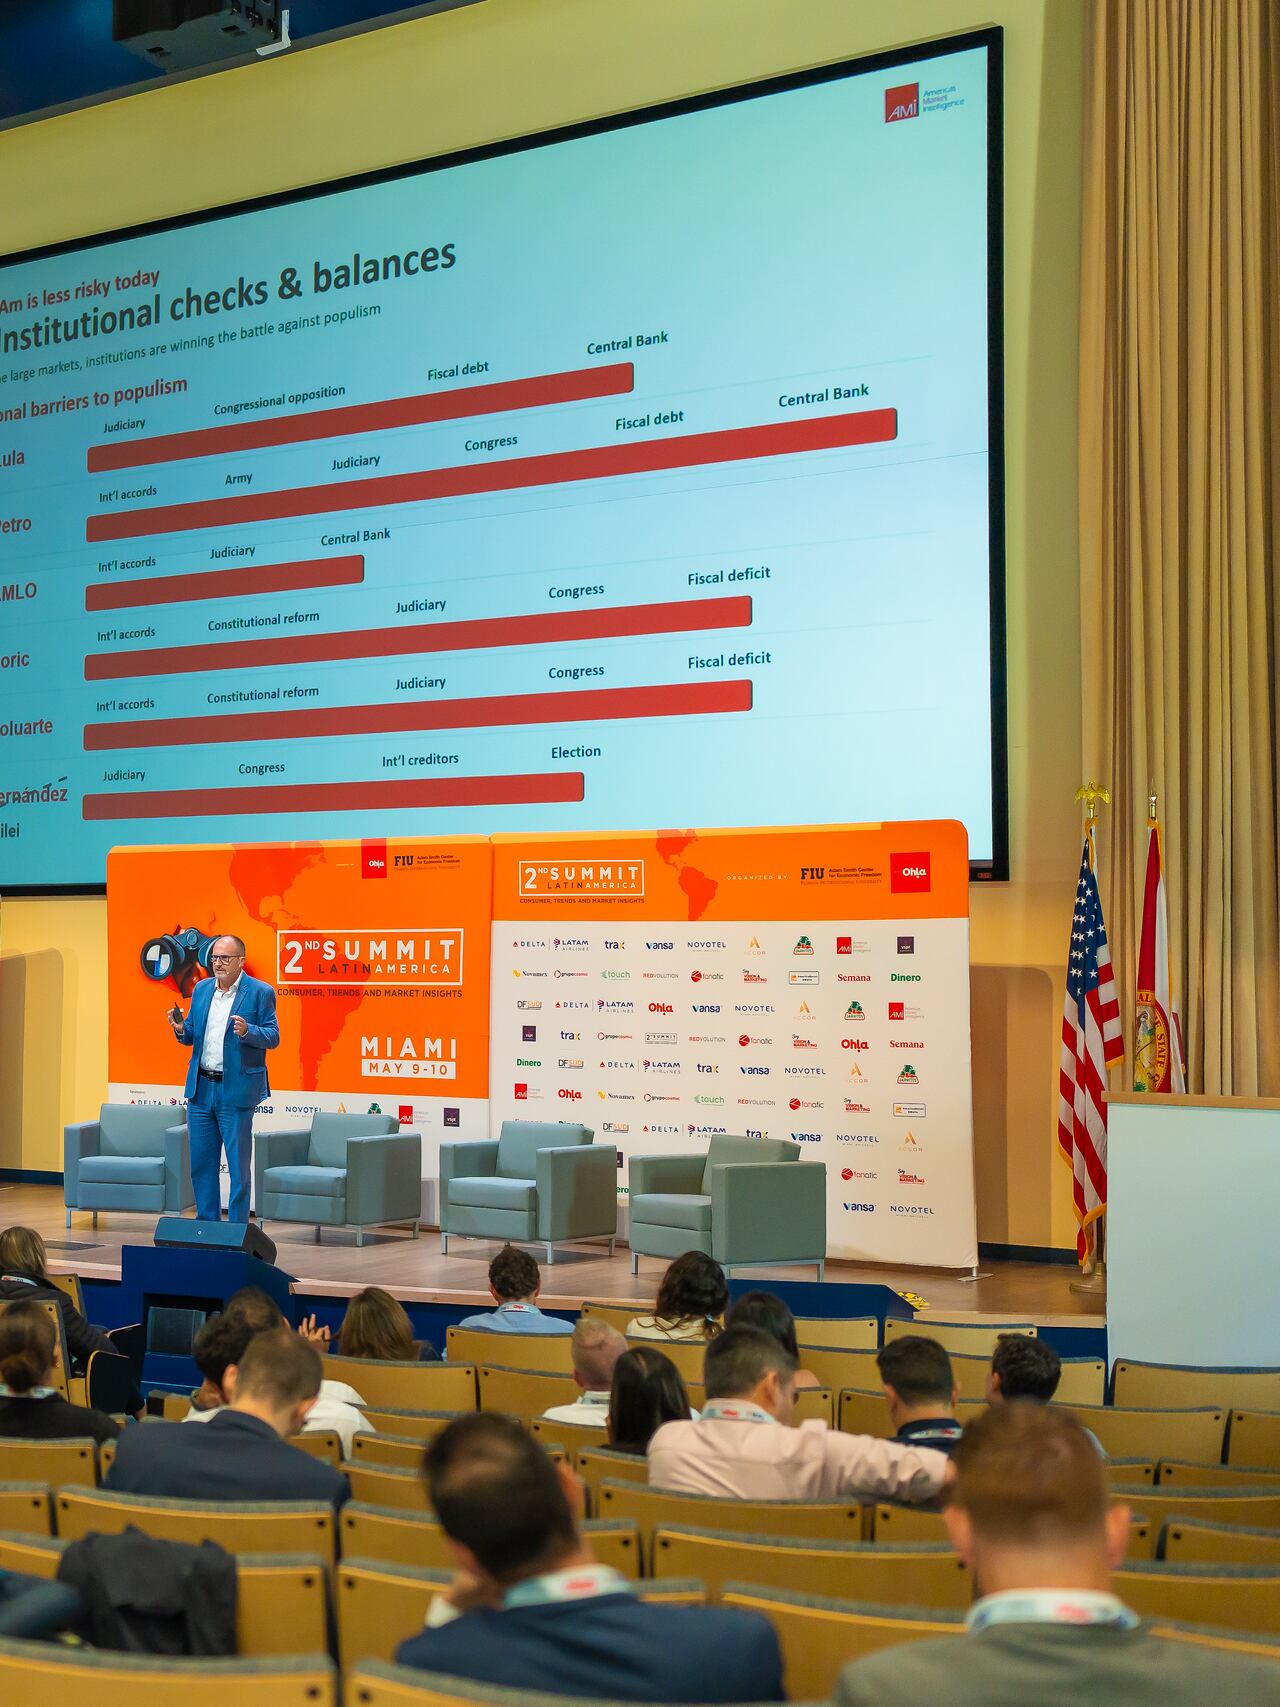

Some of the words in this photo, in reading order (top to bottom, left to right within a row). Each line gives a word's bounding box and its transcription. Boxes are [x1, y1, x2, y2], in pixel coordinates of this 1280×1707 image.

[171, 277, 268, 320] checks
[278, 268, 302, 299] &
[314, 243, 455, 293] balances
[27, 294, 38, 309] is
[43, 290, 70, 305] less
[75, 280, 110, 299] risky
[115, 270, 160, 290] today
[11, 369, 35, 381] large
[38, 360, 82, 377] markets,
[86, 350, 146, 367] institutions
[150, 344, 166, 356] are
[171, 334, 214, 351] winning
[219, 329, 237, 343] the
[241, 322, 274, 339] battle
[278, 314, 320, 334] against
[324, 304, 380, 326] populism
[587, 336, 633, 355] Central
[637, 331, 668, 348] Bank
[428, 365, 458, 381] Fiscal
[462, 360, 489, 375] debt
[31, 394, 88, 417] barriers
[93, 391, 108, 405] to
[115, 378, 187, 410] populism
[214, 394, 285, 415] Congressional
[288, 385, 345, 405] opposition
[779, 388, 829, 408] Central
[834, 384, 869, 401] Bank
[104, 418, 145, 433] Judiciary
[615, 414, 650, 431] Fiscal
[654, 410, 684, 426] debt
[465, 434, 517, 453] Congress
[332, 454, 380, 470] Judiciary
[225, 472, 252, 485] Army
[122, 486, 157, 499] accords
[321, 532, 359, 546] Central
[364, 528, 390, 541] Bank
[210, 545, 255, 559] Judiciary
[120, 557, 156, 569] accords
[688, 571, 723, 586] Fiscal
[728, 567, 770, 582] deficit
[549, 583, 604, 599] Congress
[396, 600, 446, 613] Judiciary
[208, 614, 280, 631] Constitutional
[284, 611, 319, 623] reform
[120, 627, 155, 640] accords
[688, 656, 724, 670] Fiscal
[728, 651, 771, 667] deficit
[549, 665, 604, 680] Congress
[396, 678, 446, 690] Judiciary
[207, 687, 280, 704] Constitutional
[284, 686, 319, 698] reform
[119, 698, 154, 710] accords
[409, 753, 459, 765] creditors
[551, 745, 601, 759] Election
[239, 762, 285, 775] Congress
[104, 770, 145, 782] Judiciary
[395, 856, 413, 866] FIU
[550, 867, 638, 880] SUMMIT
[801, 868, 824, 879] FIU
[322, 939, 454, 961] SUMMIT
[605, 940, 625, 949] trax
[278, 989, 324, 997] CONSUMER,
[328, 989, 360, 997] TRENDS
[364, 989, 382, 997] AND
[384, 989, 420, 997] MARKET
[422, 989, 462, 998] INSIGHTS
[561, 1031, 580, 1040] trax
[362, 1037, 456, 1059] MIAMI
[890, 1040, 924, 1048] Semana
[1156, 1033, 1165, 1067] STATE
[369, 1063, 402, 1073] MAY
[413, 1064, 447, 1075] 9-10
[697, 1064, 718, 1073] trax
[791, 1132, 820, 1141] vansa
[837, 1134, 879, 1142] NOVOTEL
[843, 1203, 874, 1211] vansa
[890, 1206, 934, 1214] NOVOTEL
